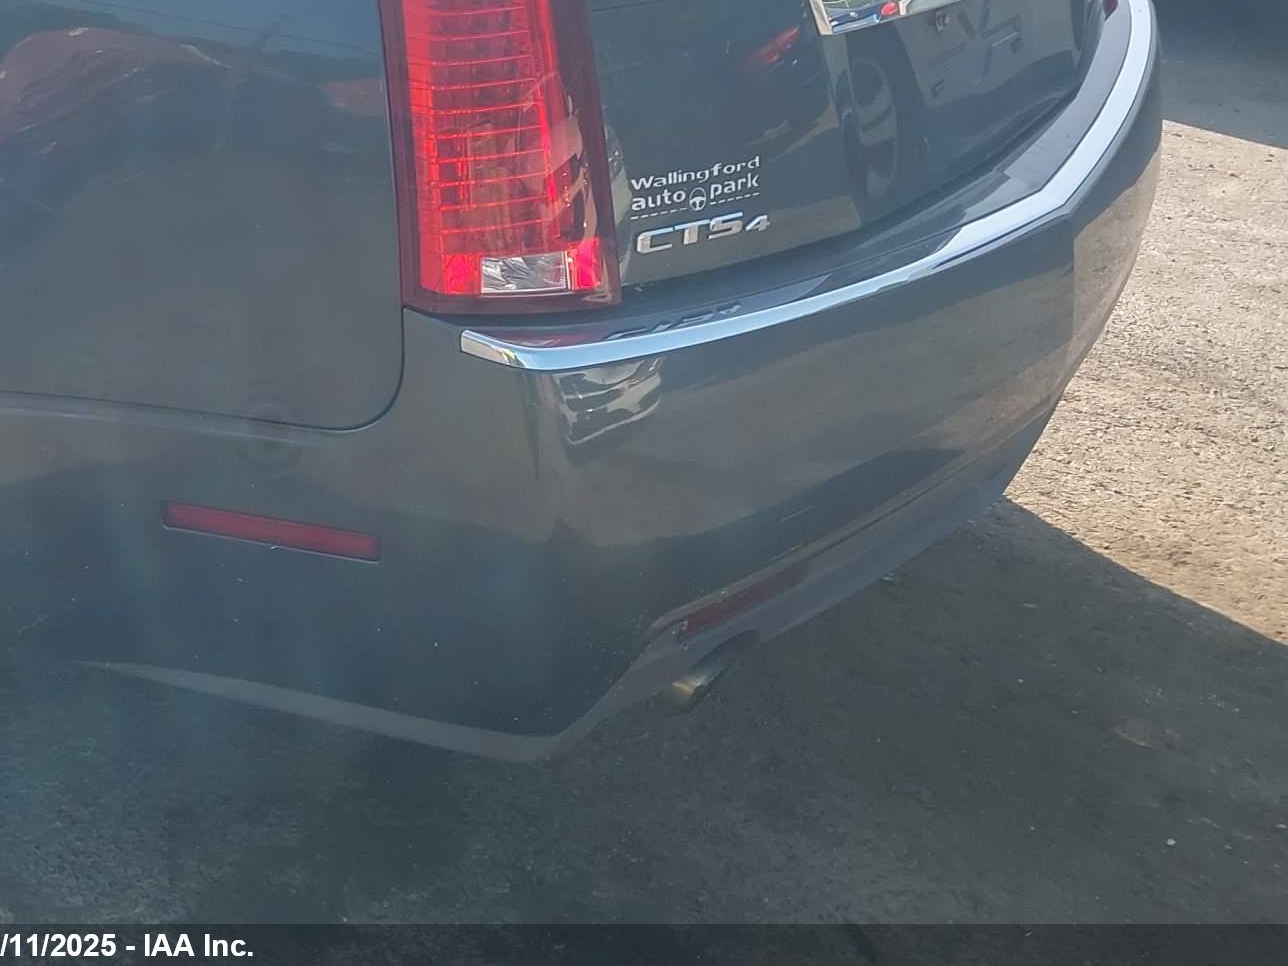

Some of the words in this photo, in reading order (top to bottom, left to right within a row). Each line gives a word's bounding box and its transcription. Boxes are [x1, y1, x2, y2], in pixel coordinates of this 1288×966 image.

[631, 155, 760, 190] Wallingford
[631, 188, 686, 211] auto
[710, 172, 759, 200] park
